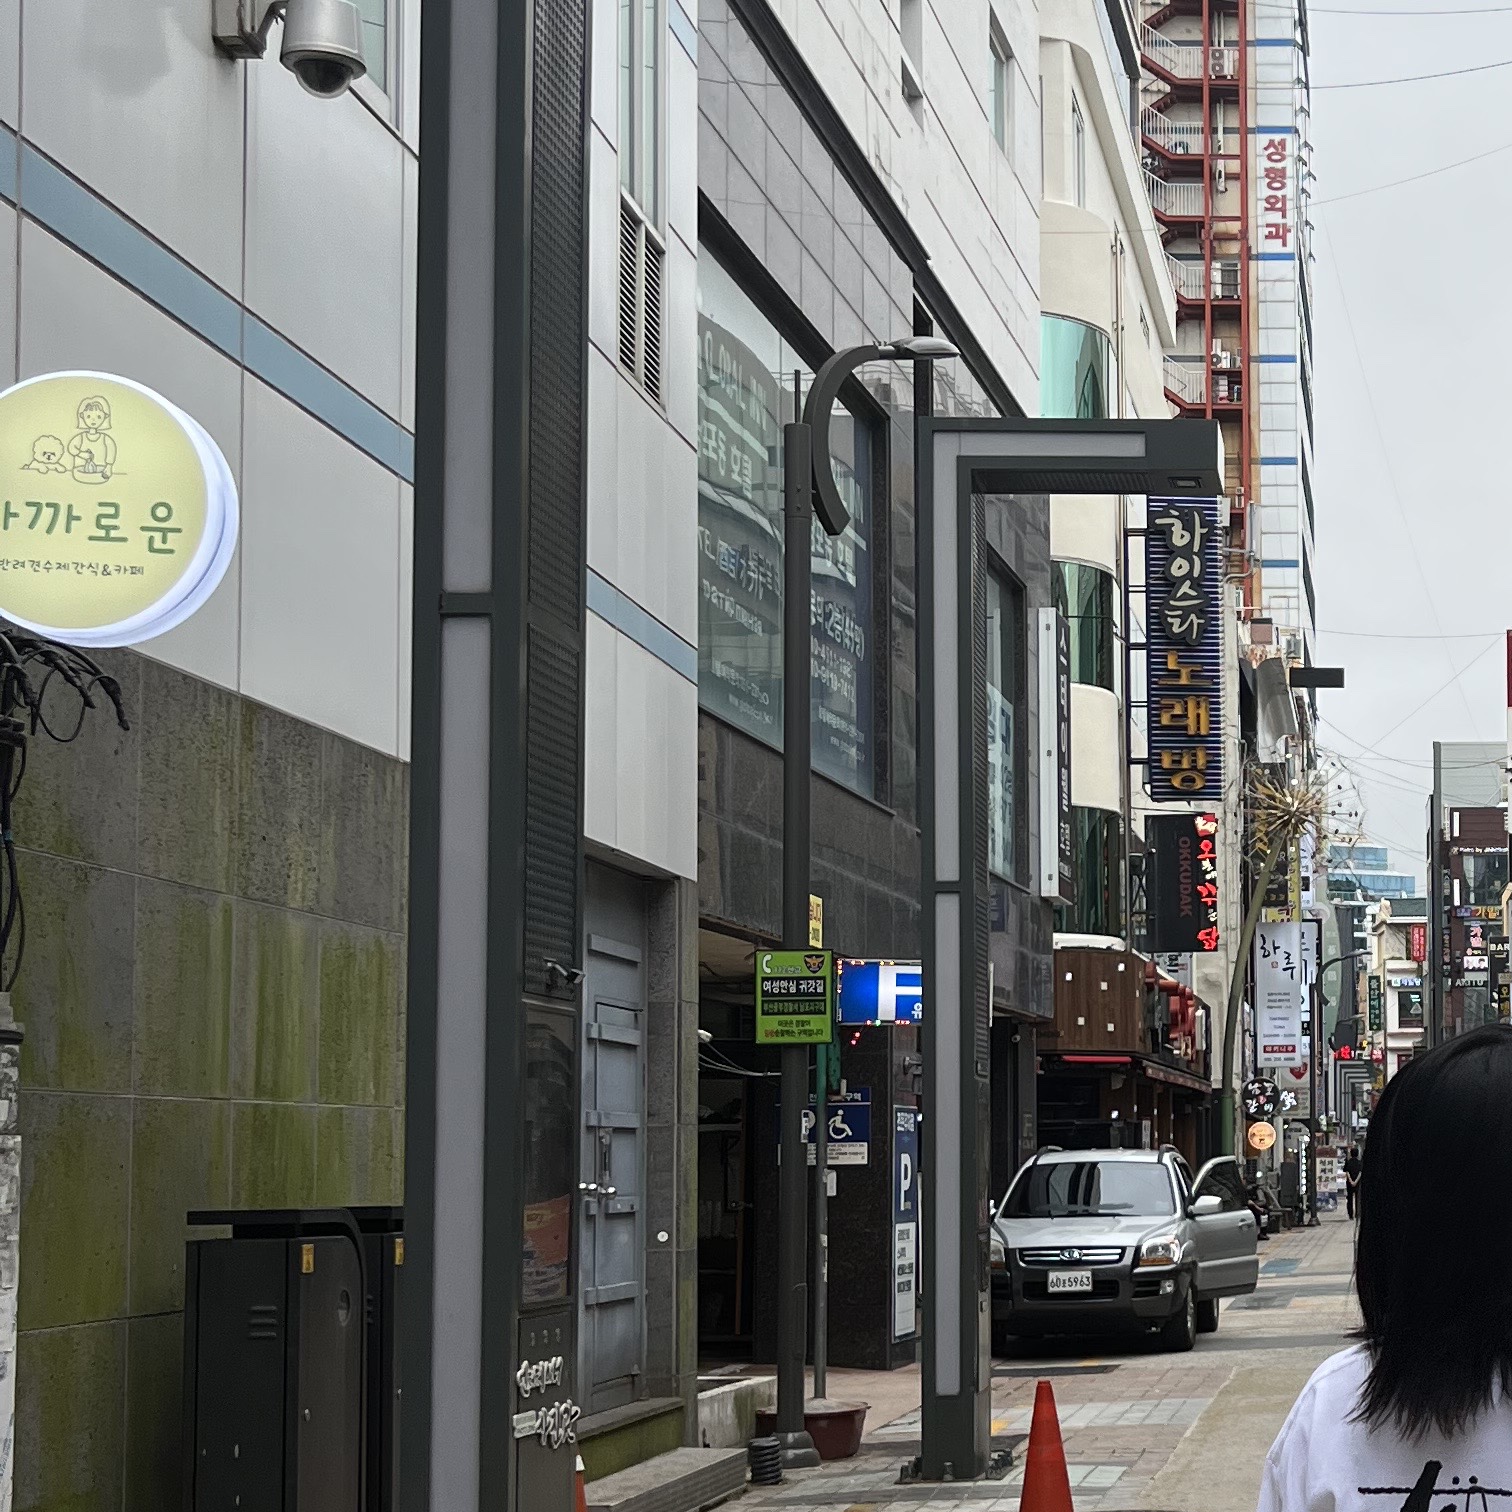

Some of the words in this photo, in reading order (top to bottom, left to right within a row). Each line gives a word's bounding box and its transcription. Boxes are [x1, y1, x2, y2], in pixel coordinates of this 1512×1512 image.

[1263, 138, 1291, 248] 성형외과
[1155, 510, 1208, 640] 하이스타
[1157, 651, 1214, 790] 노래방
[1179, 836, 1192, 918] OKKUDAK
[763, 980, 797, 993] 여성안심
[799, 980, 824, 993] 귀갓길
[900, 1153, 911, 1211] P
